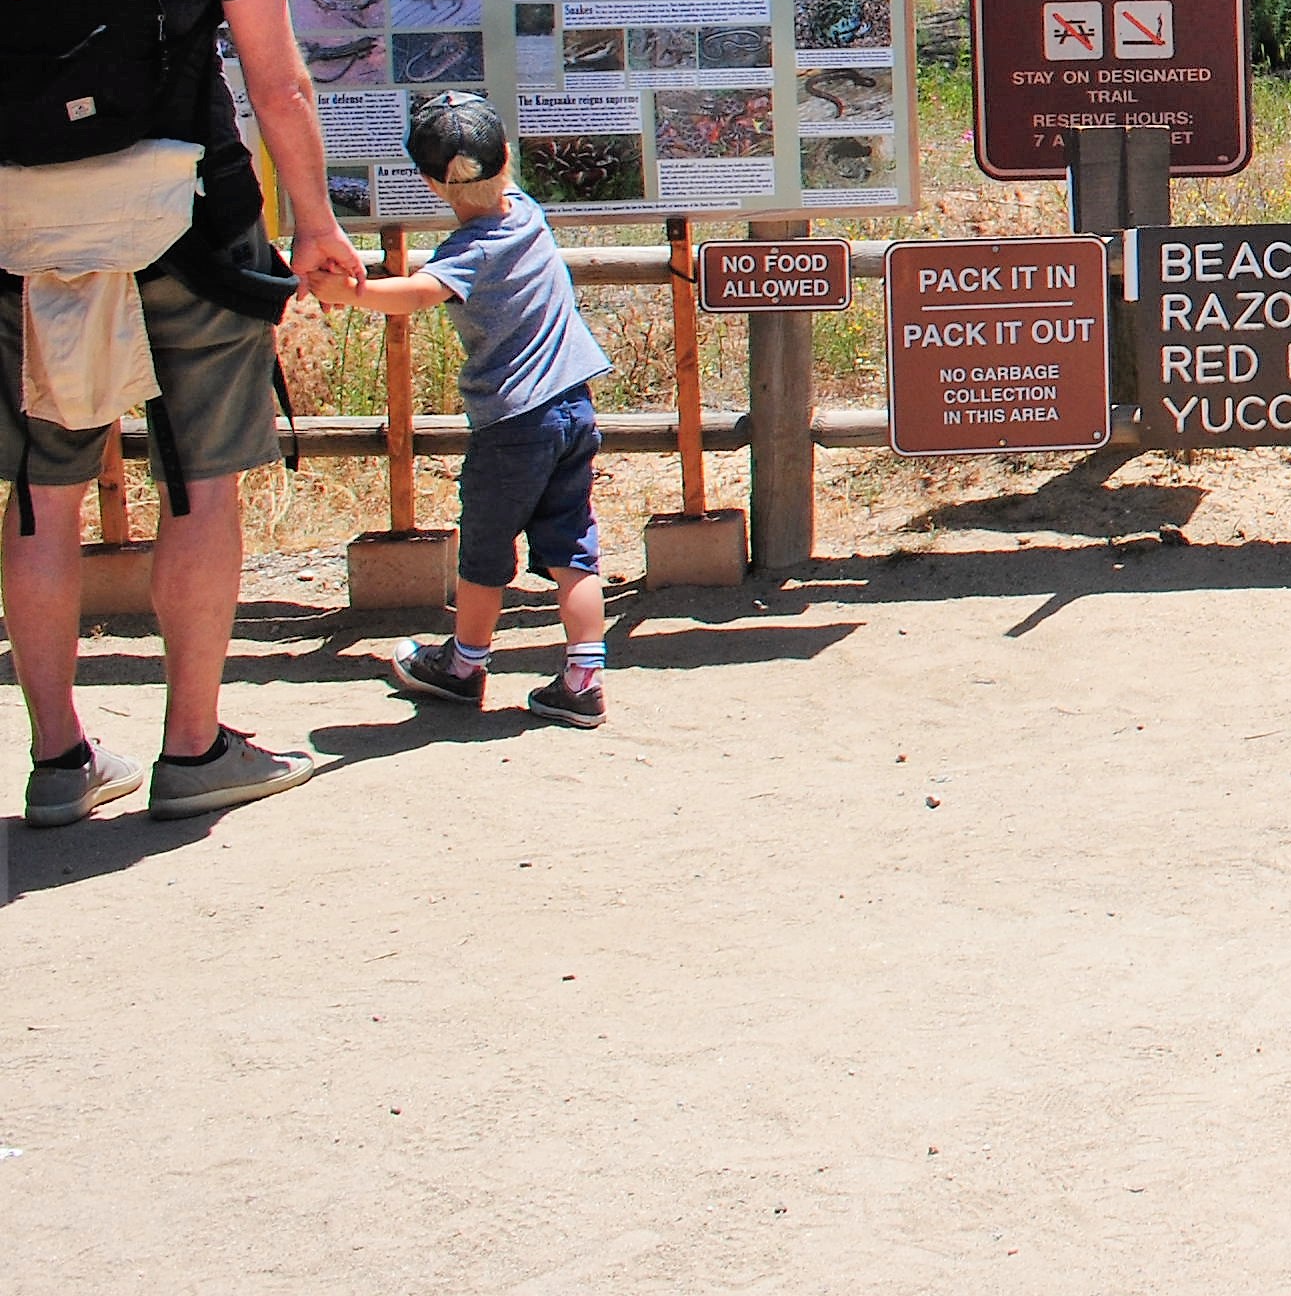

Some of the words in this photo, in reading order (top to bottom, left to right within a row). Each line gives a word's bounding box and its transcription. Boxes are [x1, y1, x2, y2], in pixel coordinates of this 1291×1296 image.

[564, 4, 594, 16] Snakes
[1012, 71, 1054, 85] STAY
[1063, 70, 1090, 85] ON
[1099, 68, 1211, 84] DESIGNATED
[318, 94, 330, 104] for
[332, 93, 363, 104] defense
[518, 95, 533, 106] The
[535, 94, 577, 107] Kingsnake
[579, 94, 604, 106] reigns
[606, 95, 639, 106] supreme
[1088, 90, 1139, 104] TRAIL
[1033, 112, 1116, 128] RESERVE
[1125, 111, 1194, 126] HOURS:
[1034, 134, 1045, 147] 7
[378, 166, 389, 176] An
[722, 255, 756, 274] NO
[764, 253, 828, 273] FOOD
[918, 266, 1000, 293] PACK
[1011, 265, 1038, 290] IT
[1046, 264, 1076, 289] IN
[722, 279, 829, 298] ALLOWED
[903, 321, 987, 348] PACK
[996, 320, 1023, 346] IT
[1031, 317, 1095, 345] OUT
[1161, 344, 1259, 385] RED
[939, 367, 967, 383] NO
[971, 364, 1060, 383] GARBAGE
[943, 386, 1057, 405] COLLECTION
[943, 409, 962, 425] IN
[965, 408, 1006, 424] THIS
[1009, 407, 1060, 423] AREA
